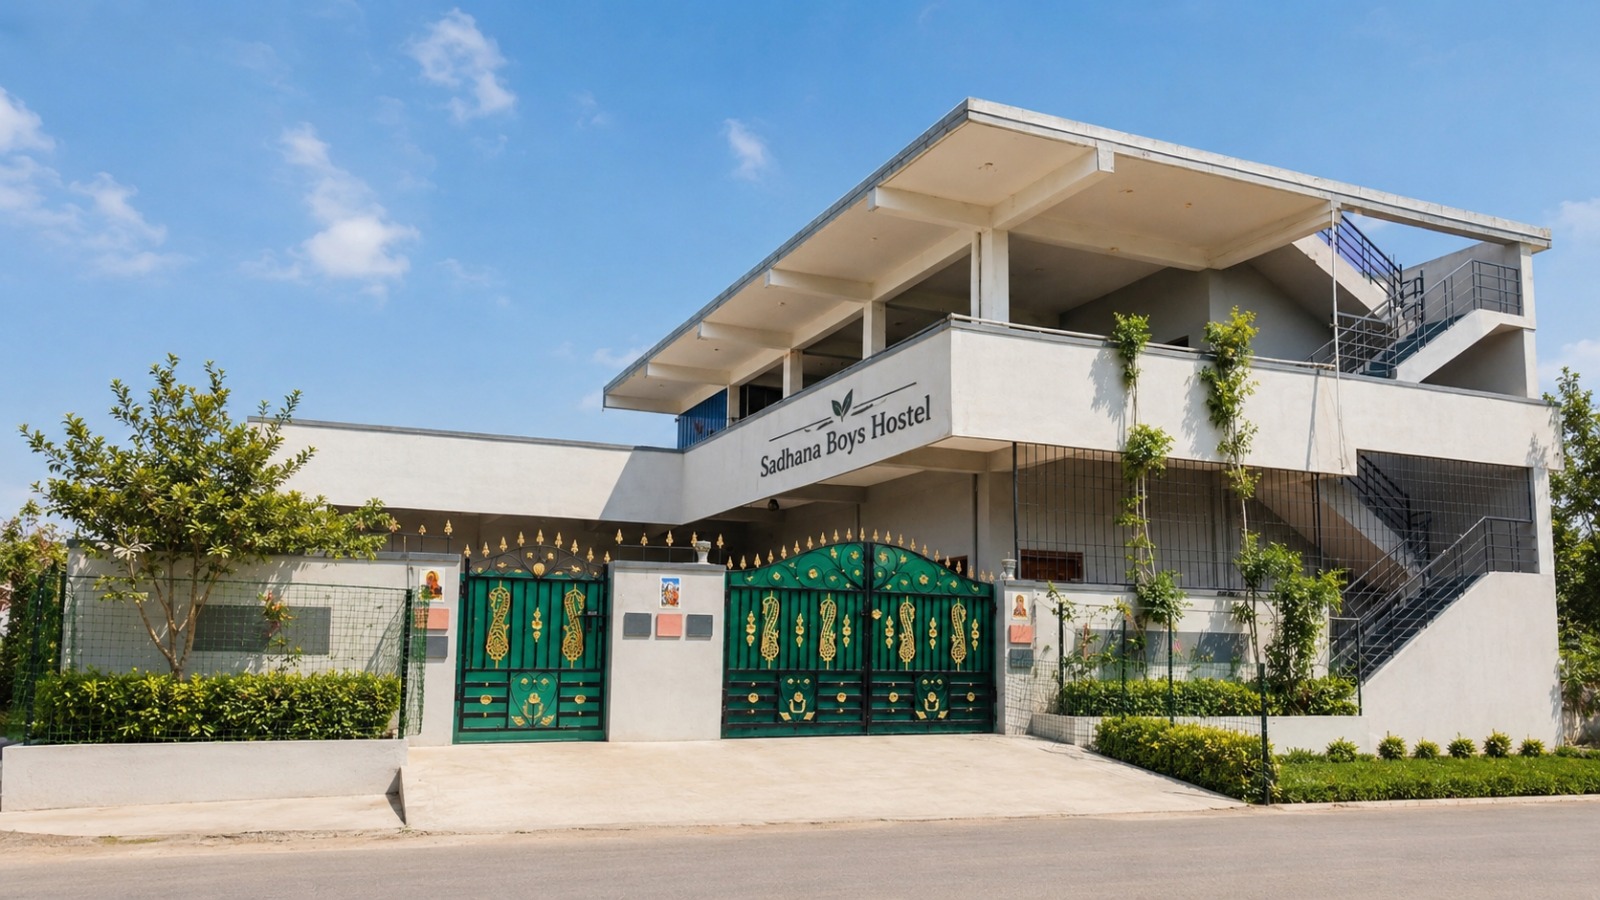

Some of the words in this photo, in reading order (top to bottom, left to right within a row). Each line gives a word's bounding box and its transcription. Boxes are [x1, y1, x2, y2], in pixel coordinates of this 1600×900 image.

[760, 444, 821, 478] Sadhana
[826, 427, 866, 455] Boys
[871, 394, 931, 440] Hostel
